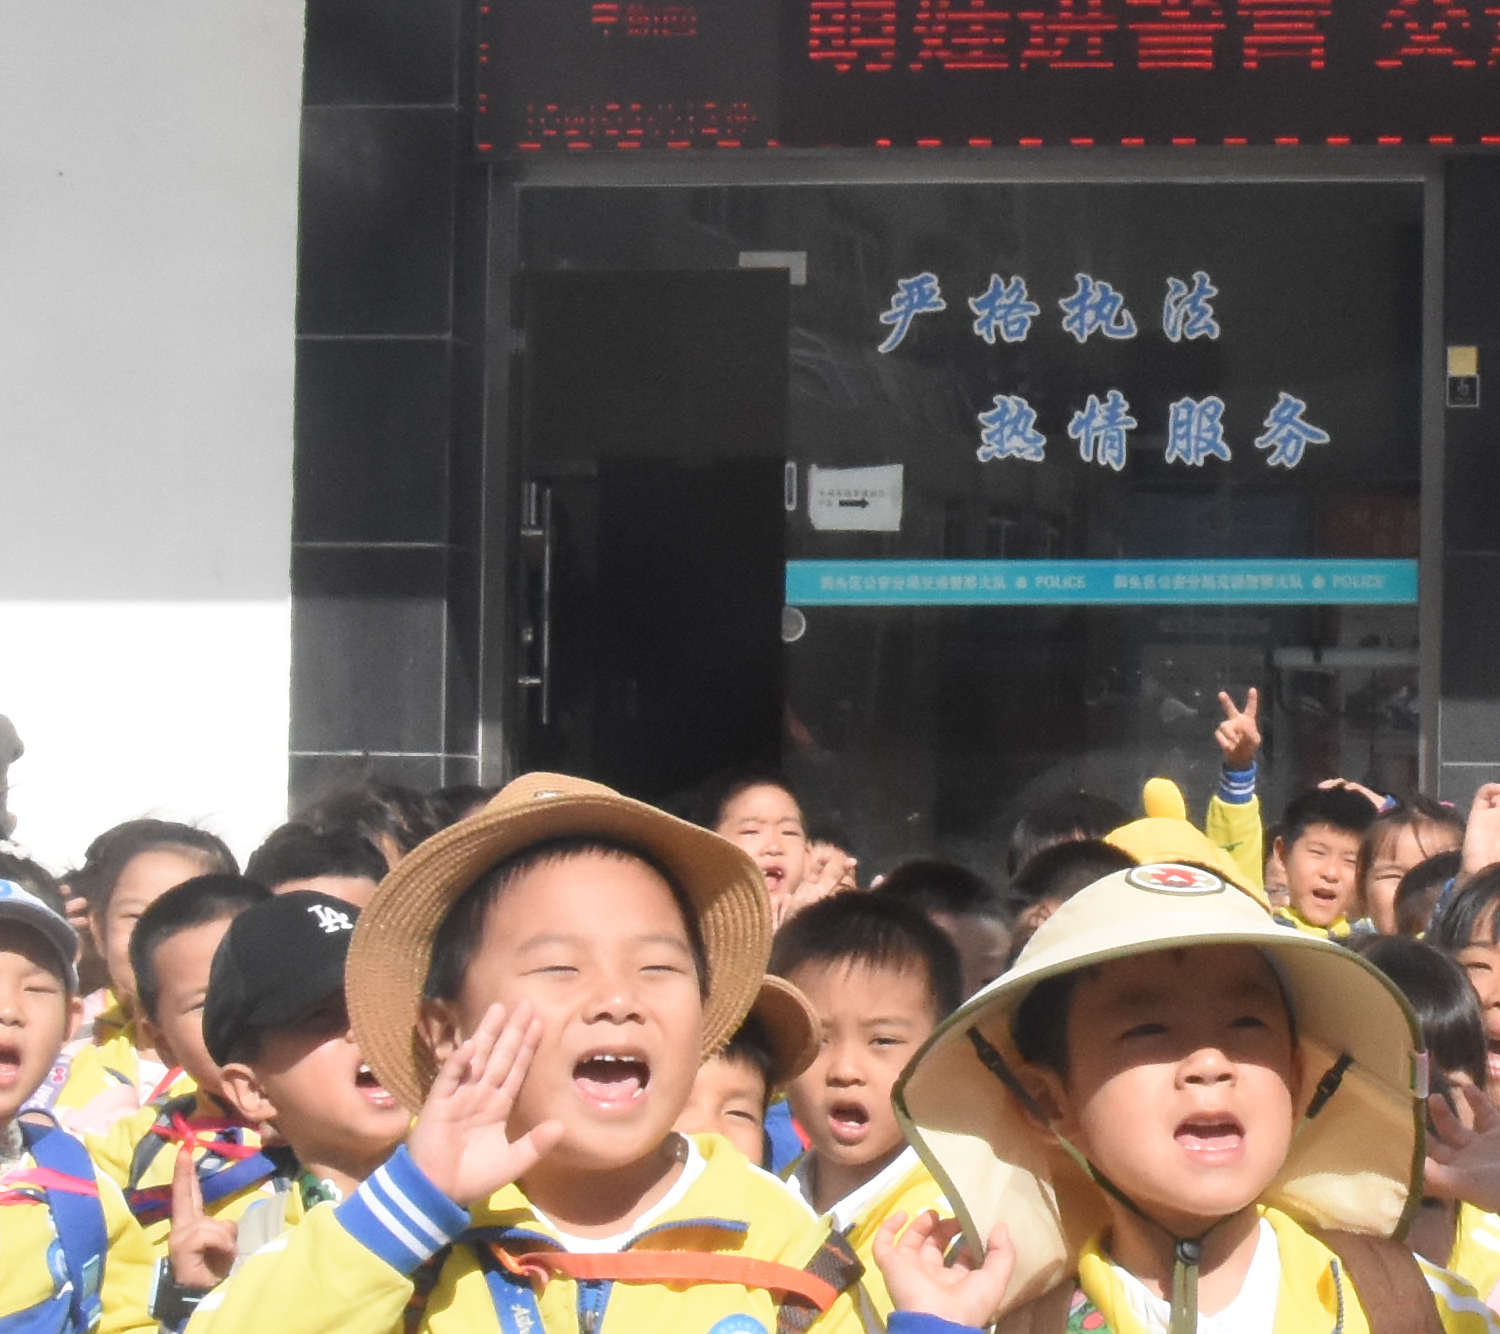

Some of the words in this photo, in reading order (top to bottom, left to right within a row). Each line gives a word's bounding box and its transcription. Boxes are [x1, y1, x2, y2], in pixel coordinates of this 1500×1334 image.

[878, 271, 1221, 354] 严格执法
[976, 390, 1330, 470] 热情服务
